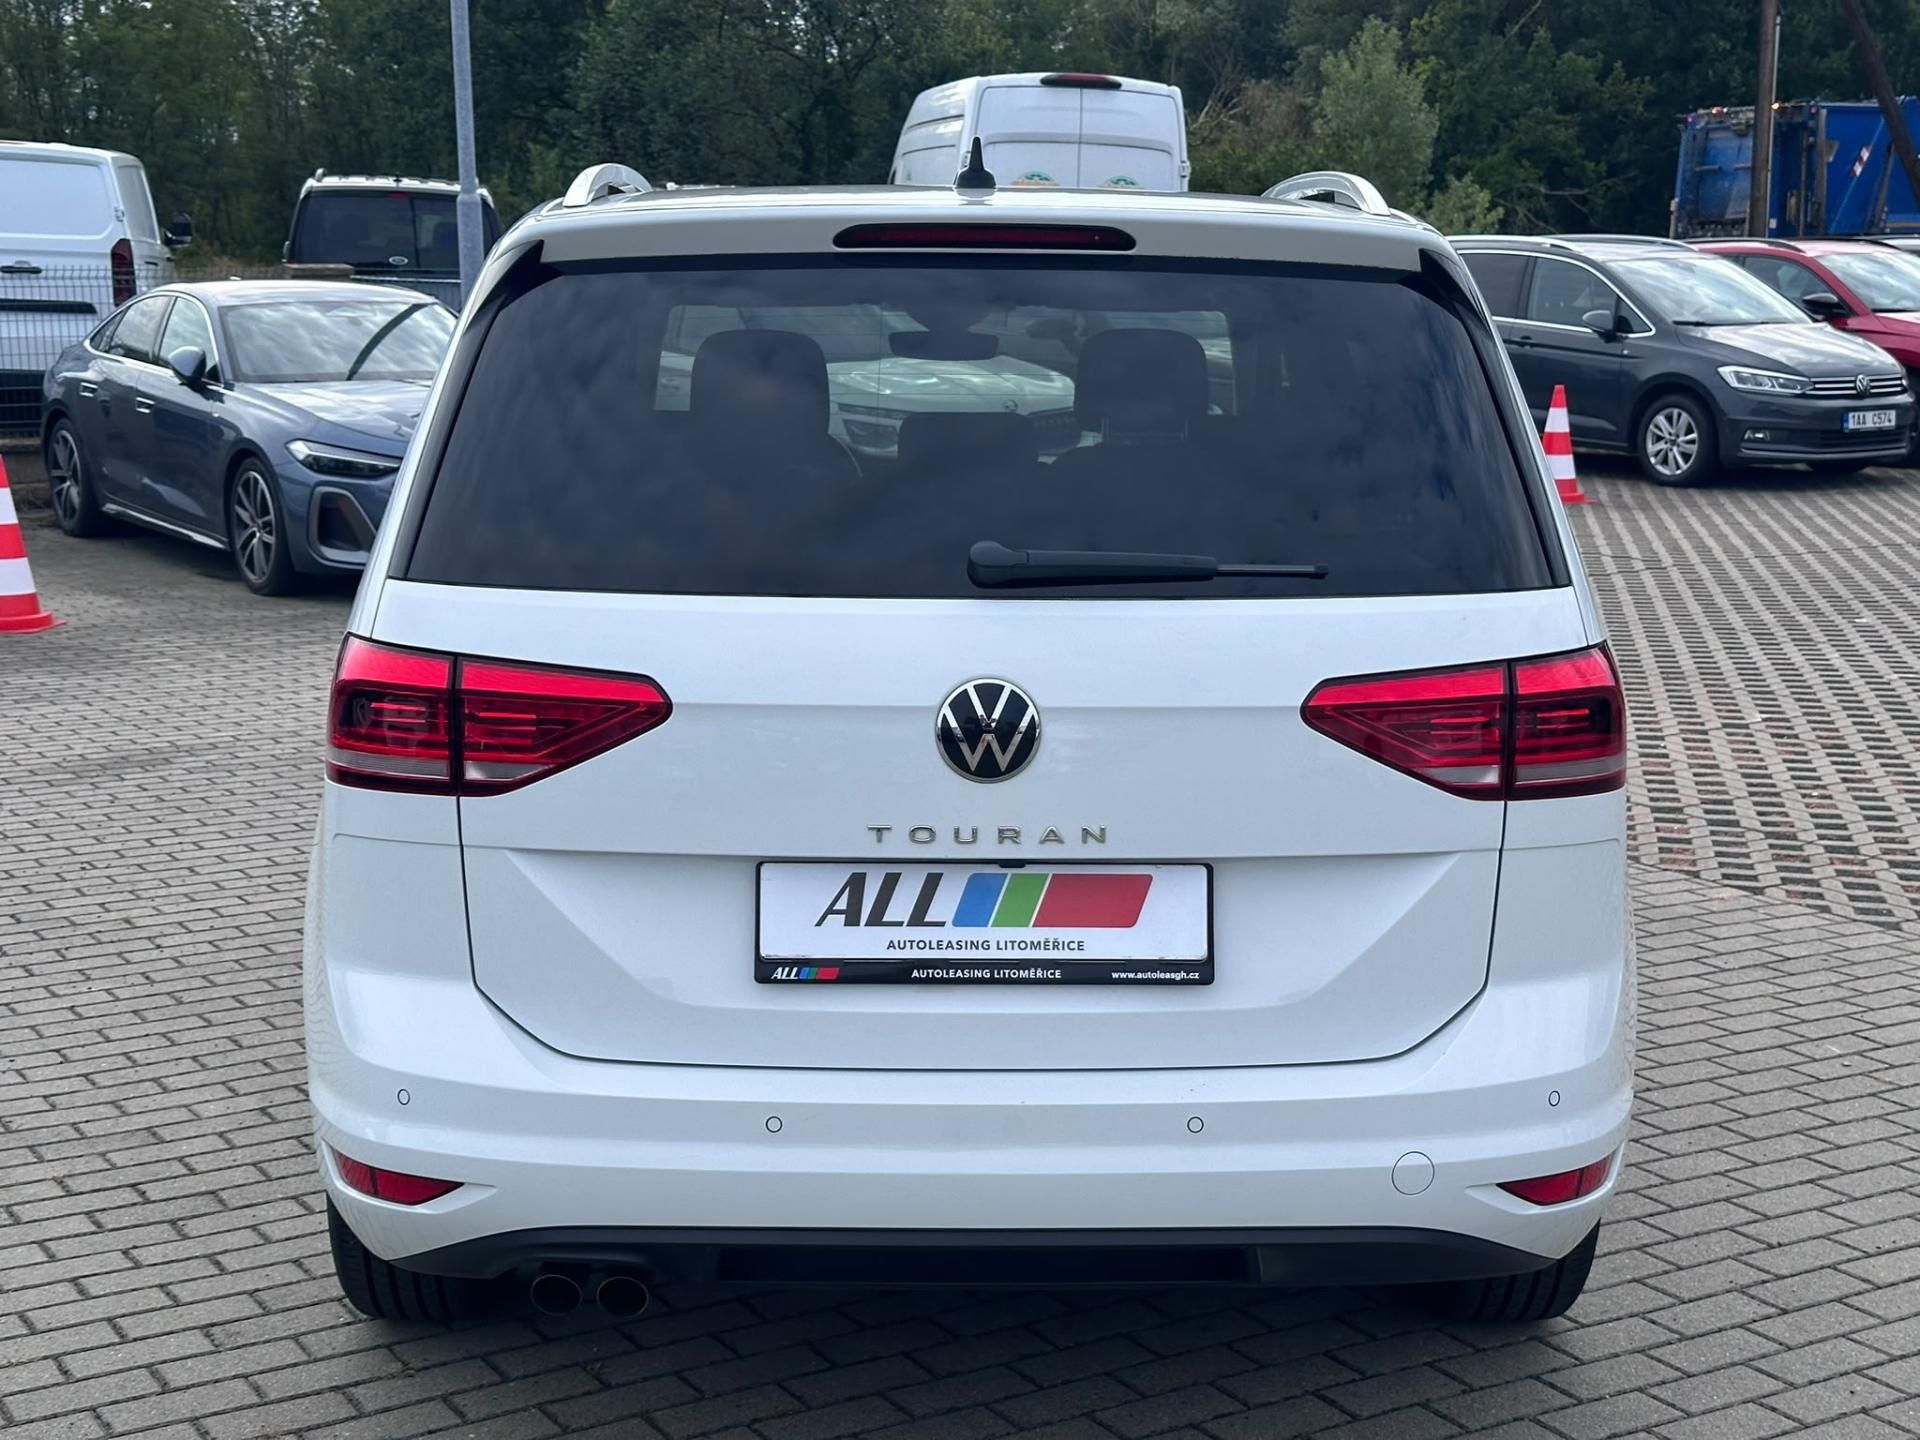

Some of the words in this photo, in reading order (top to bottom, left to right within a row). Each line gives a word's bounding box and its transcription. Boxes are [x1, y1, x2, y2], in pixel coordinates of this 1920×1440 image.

[1851, 413, 1867, 426] 1AA
[1872, 412, 1892, 425] C574
[866, 824, 1108, 845] TOURAN
[813, 871, 947, 928] ALL
[886, 939, 991, 951] AUTOLEASING
[996, 936, 1086, 951] LITOMĚŘICE
[770, 966, 799, 980] ALL
[911, 968, 991, 979] AUTOLEASING
[994, 966, 1062, 979] LITOMĚŘICE
[1111, 969, 1200, 981] www.autoleasgh.cz
